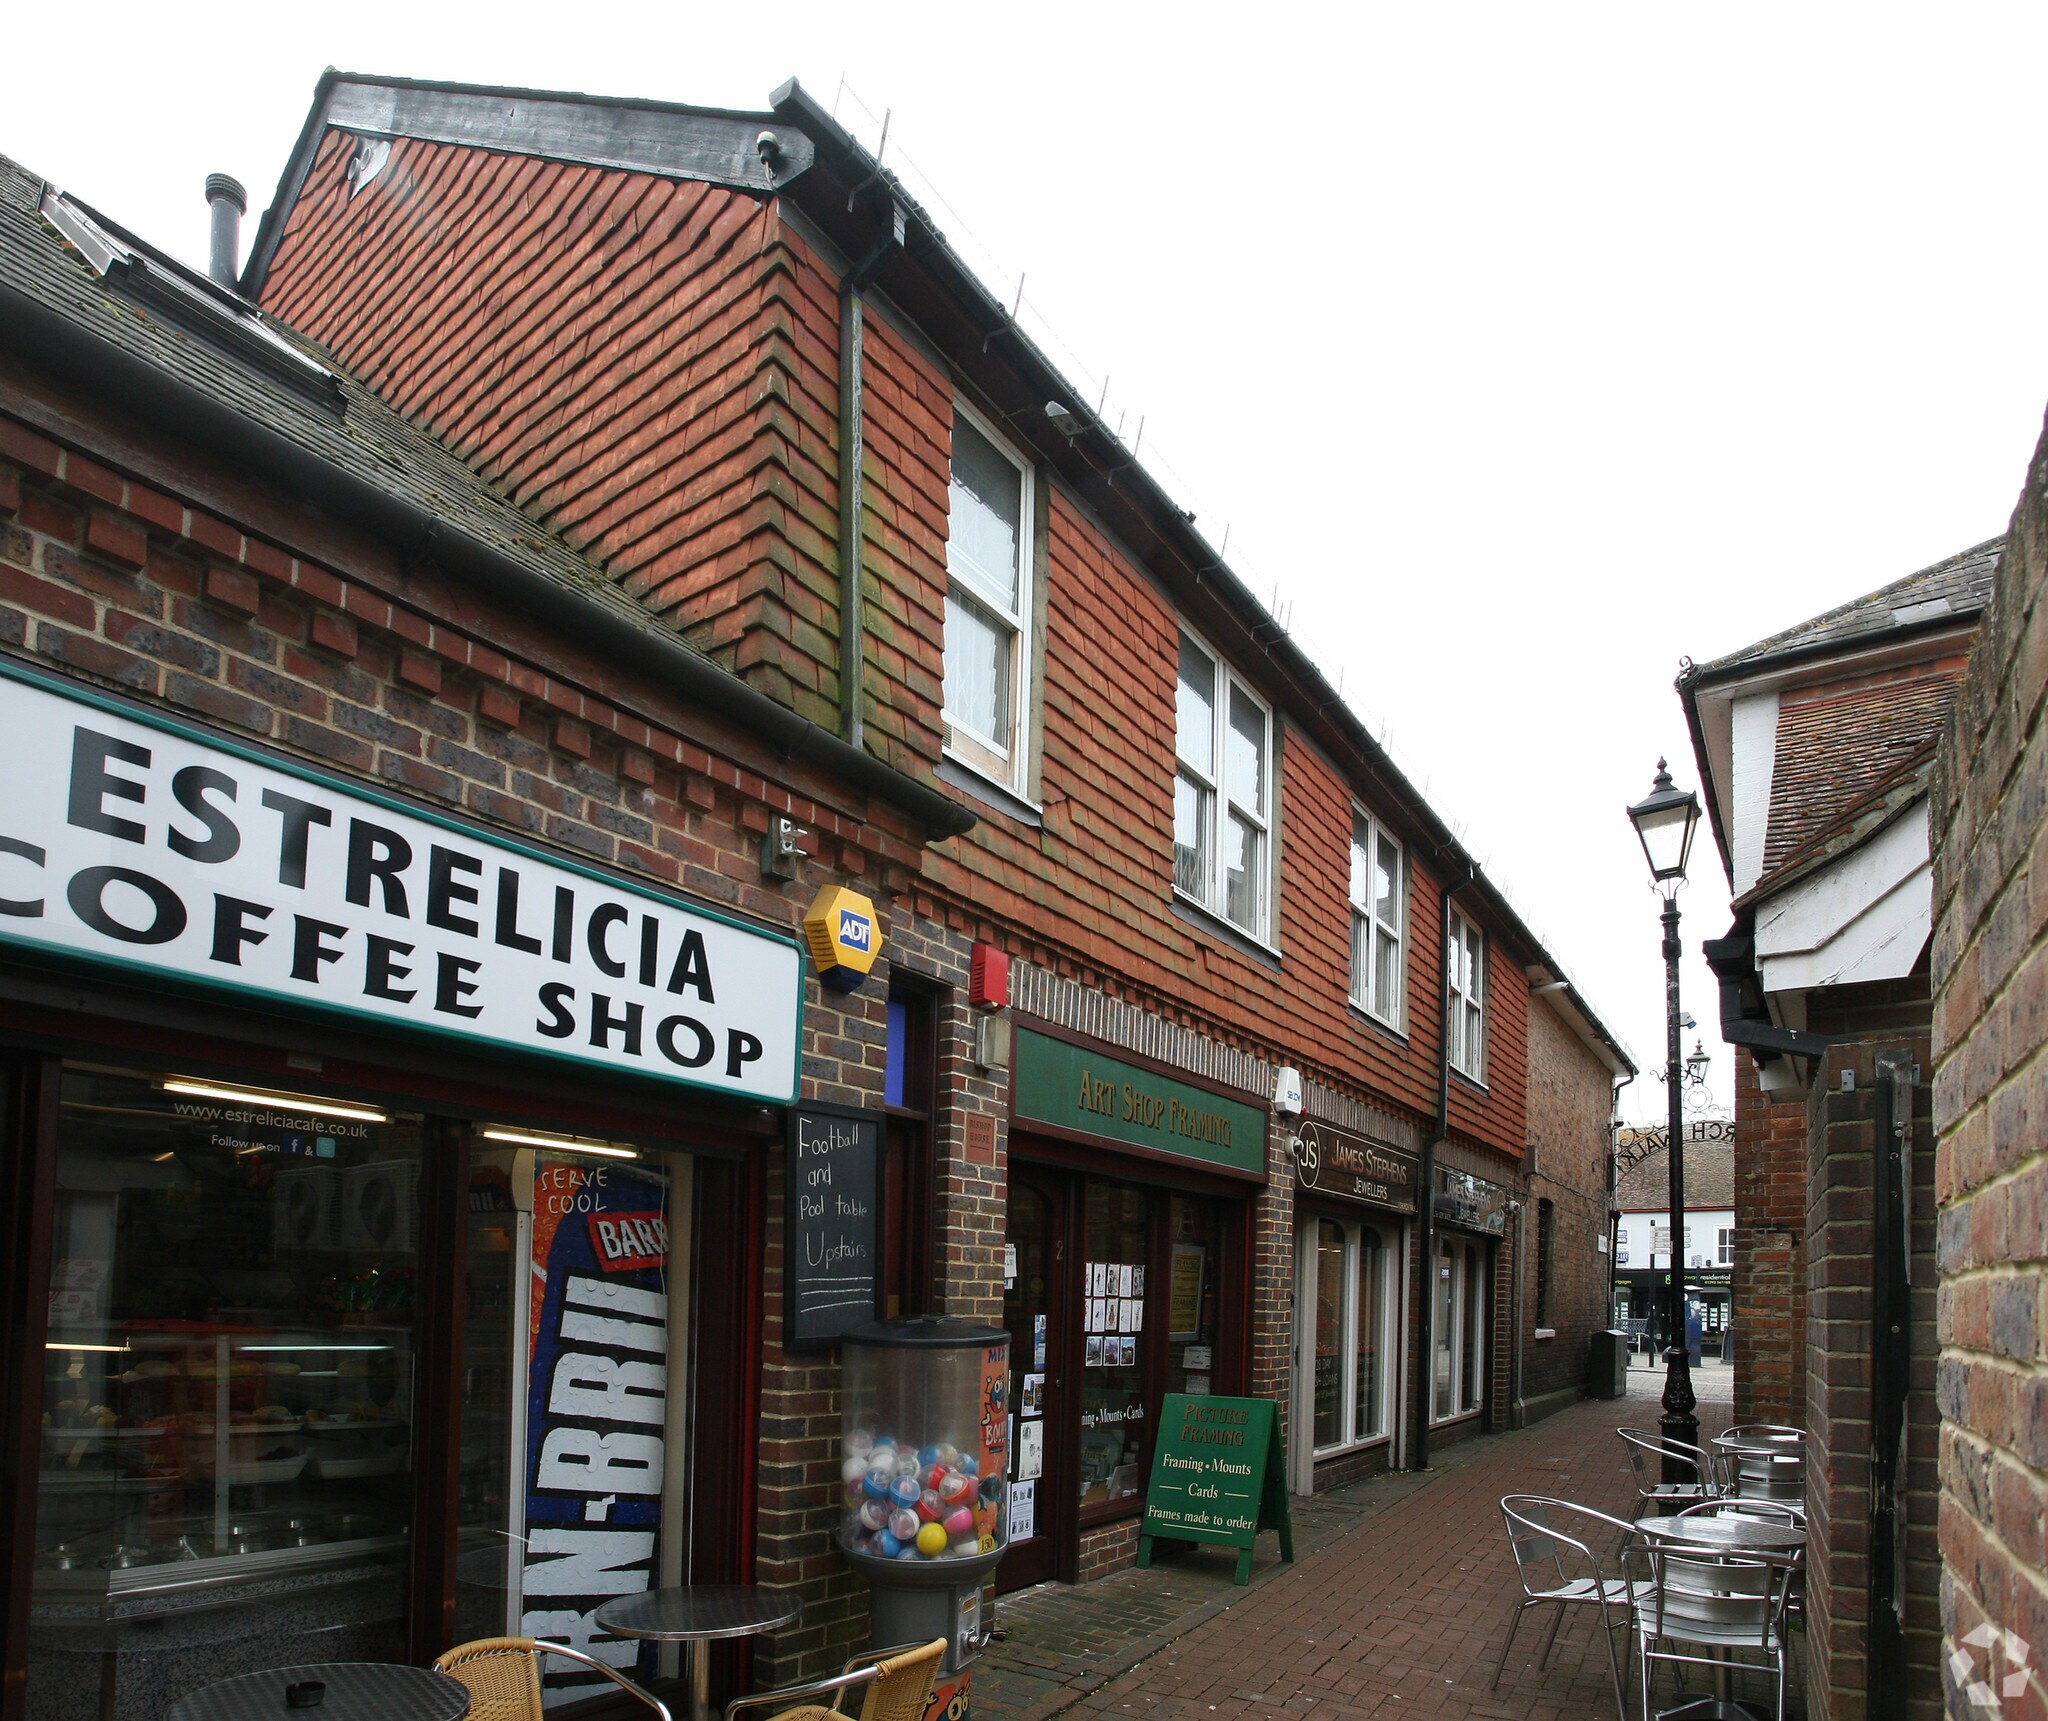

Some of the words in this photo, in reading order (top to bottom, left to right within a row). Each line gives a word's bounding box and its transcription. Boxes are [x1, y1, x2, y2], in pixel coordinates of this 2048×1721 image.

[67, 725, 715, 1004] ESTRELICIA
[840, 918, 870, 944] ADT
[536, 981, 764, 1079] SHOP
[174, 1103, 368, 1138] www.estreliciacafe.co.uk
[1078, 1070, 1116, 1117] ART
[1122, 1082, 1165, 1130] SHOP
[1170, 1097, 1232, 1148] FRAMING
[211, 1135, 249, 1148] Follow
[266, 1143, 280, 1152] on
[800, 1117, 859, 1158] Football
[1300, 1139, 1317, 1169] JS
[1332, 1140, 1364, 1175] JAMES
[1366, 1149, 1407, 1185] STEPHENS
[541, 1166, 608, 1191] SERVE
[808, 1163, 831, 1186] and
[1353, 1177, 1388, 1200] JEWELLERS
[548, 1192, 608, 1215] COOL
[800, 1194, 825, 1220] Pool
[835, 1194, 868, 1217] table
[806, 1231, 867, 1270] Upstairs
[1099, 1408, 1123, 1424] Mounts
[1126, 1403, 1144, 1420] Cards
[1183, 1403, 1248, 1425] PICTURE
[1181, 1424, 1244, 1446] FRAMING
[1162, 1453, 1204, 1474] Framing
[1211, 1458, 1252, 1475] Mounts
[1188, 1482, 1218, 1499] Cards
[1148, 1505, 1181, 1521] Frames
[1184, 1511, 1210, 1524] made
[1213, 1515, 1223, 1526] to
[1226, 1515, 1253, 1530] order
